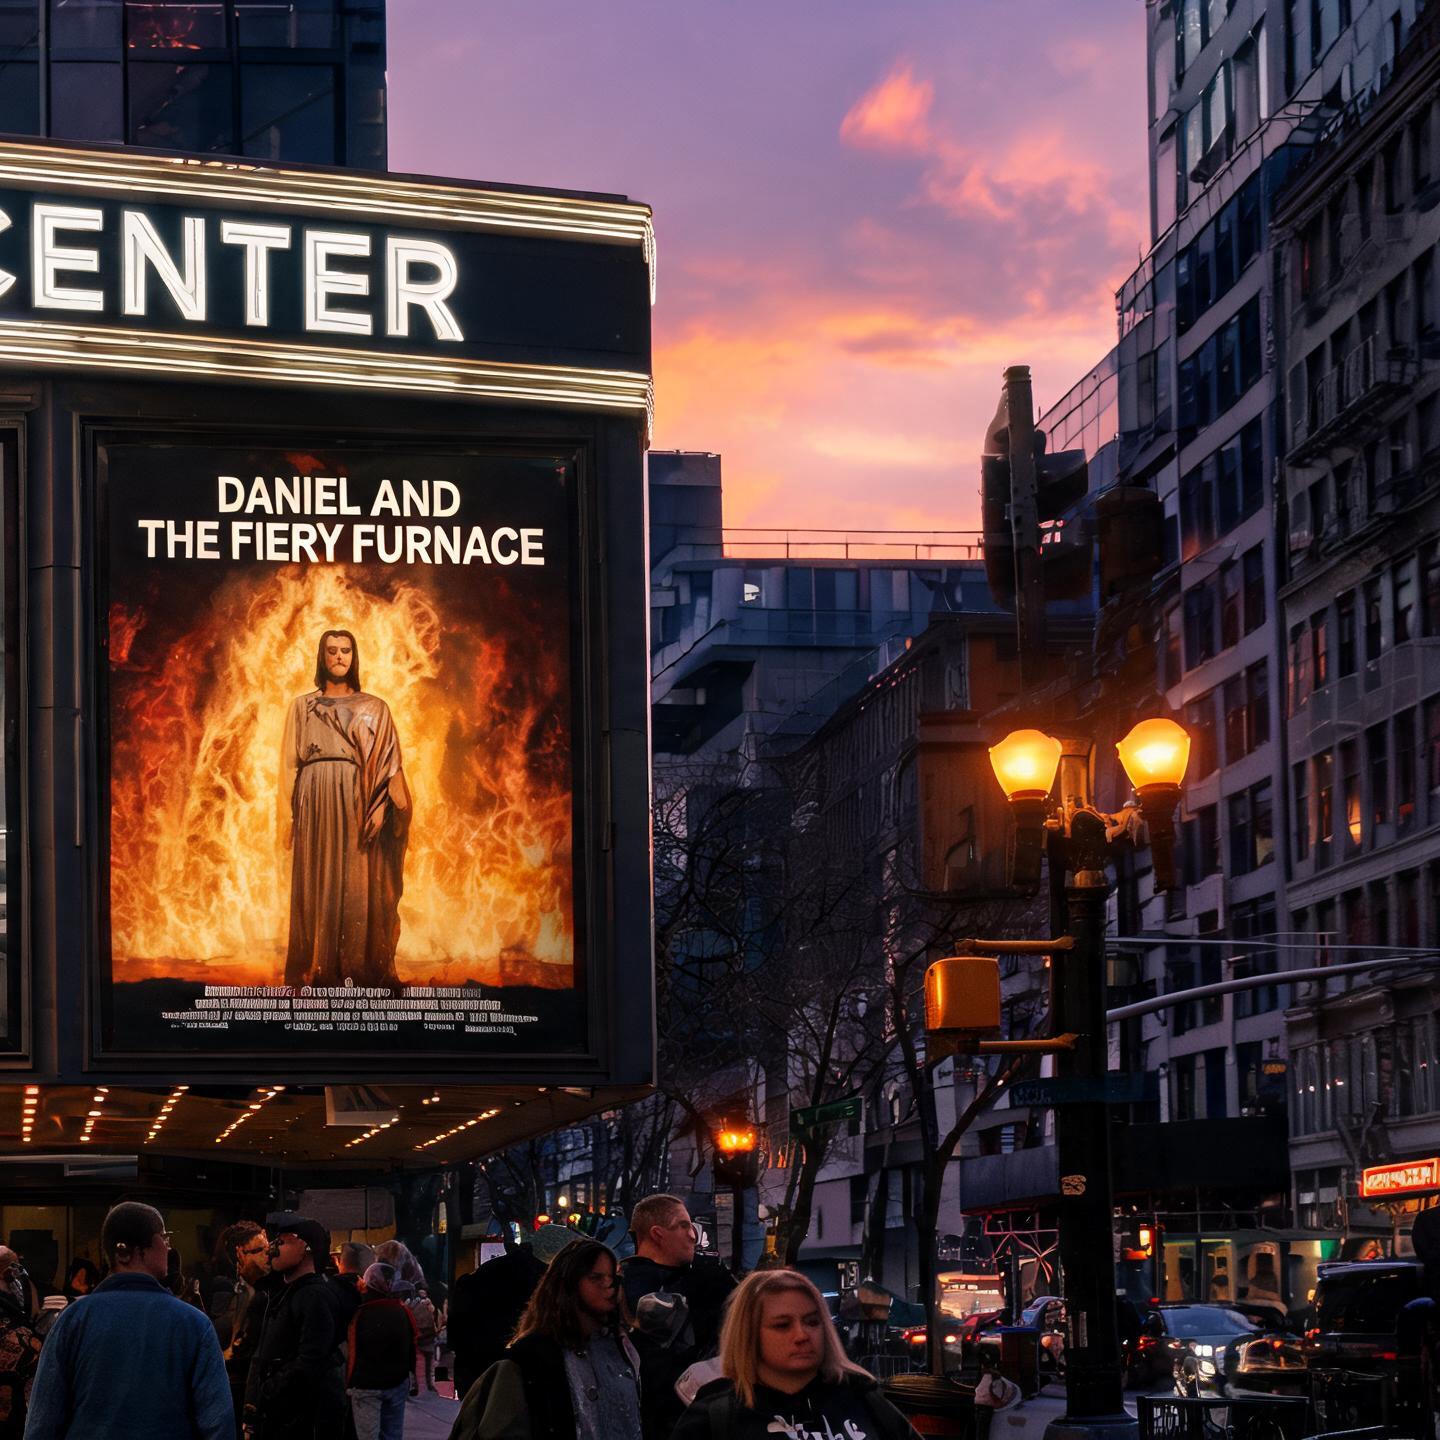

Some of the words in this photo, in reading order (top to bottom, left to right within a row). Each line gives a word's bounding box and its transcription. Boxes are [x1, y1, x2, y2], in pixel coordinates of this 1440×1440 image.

[217, 476, 361, 515] DANIEL
[370, 479, 461, 517] AND
[138, 519, 220, 560] THE
[231, 521, 345, 564] FIERY
[352, 524, 546, 566] FURNACE
